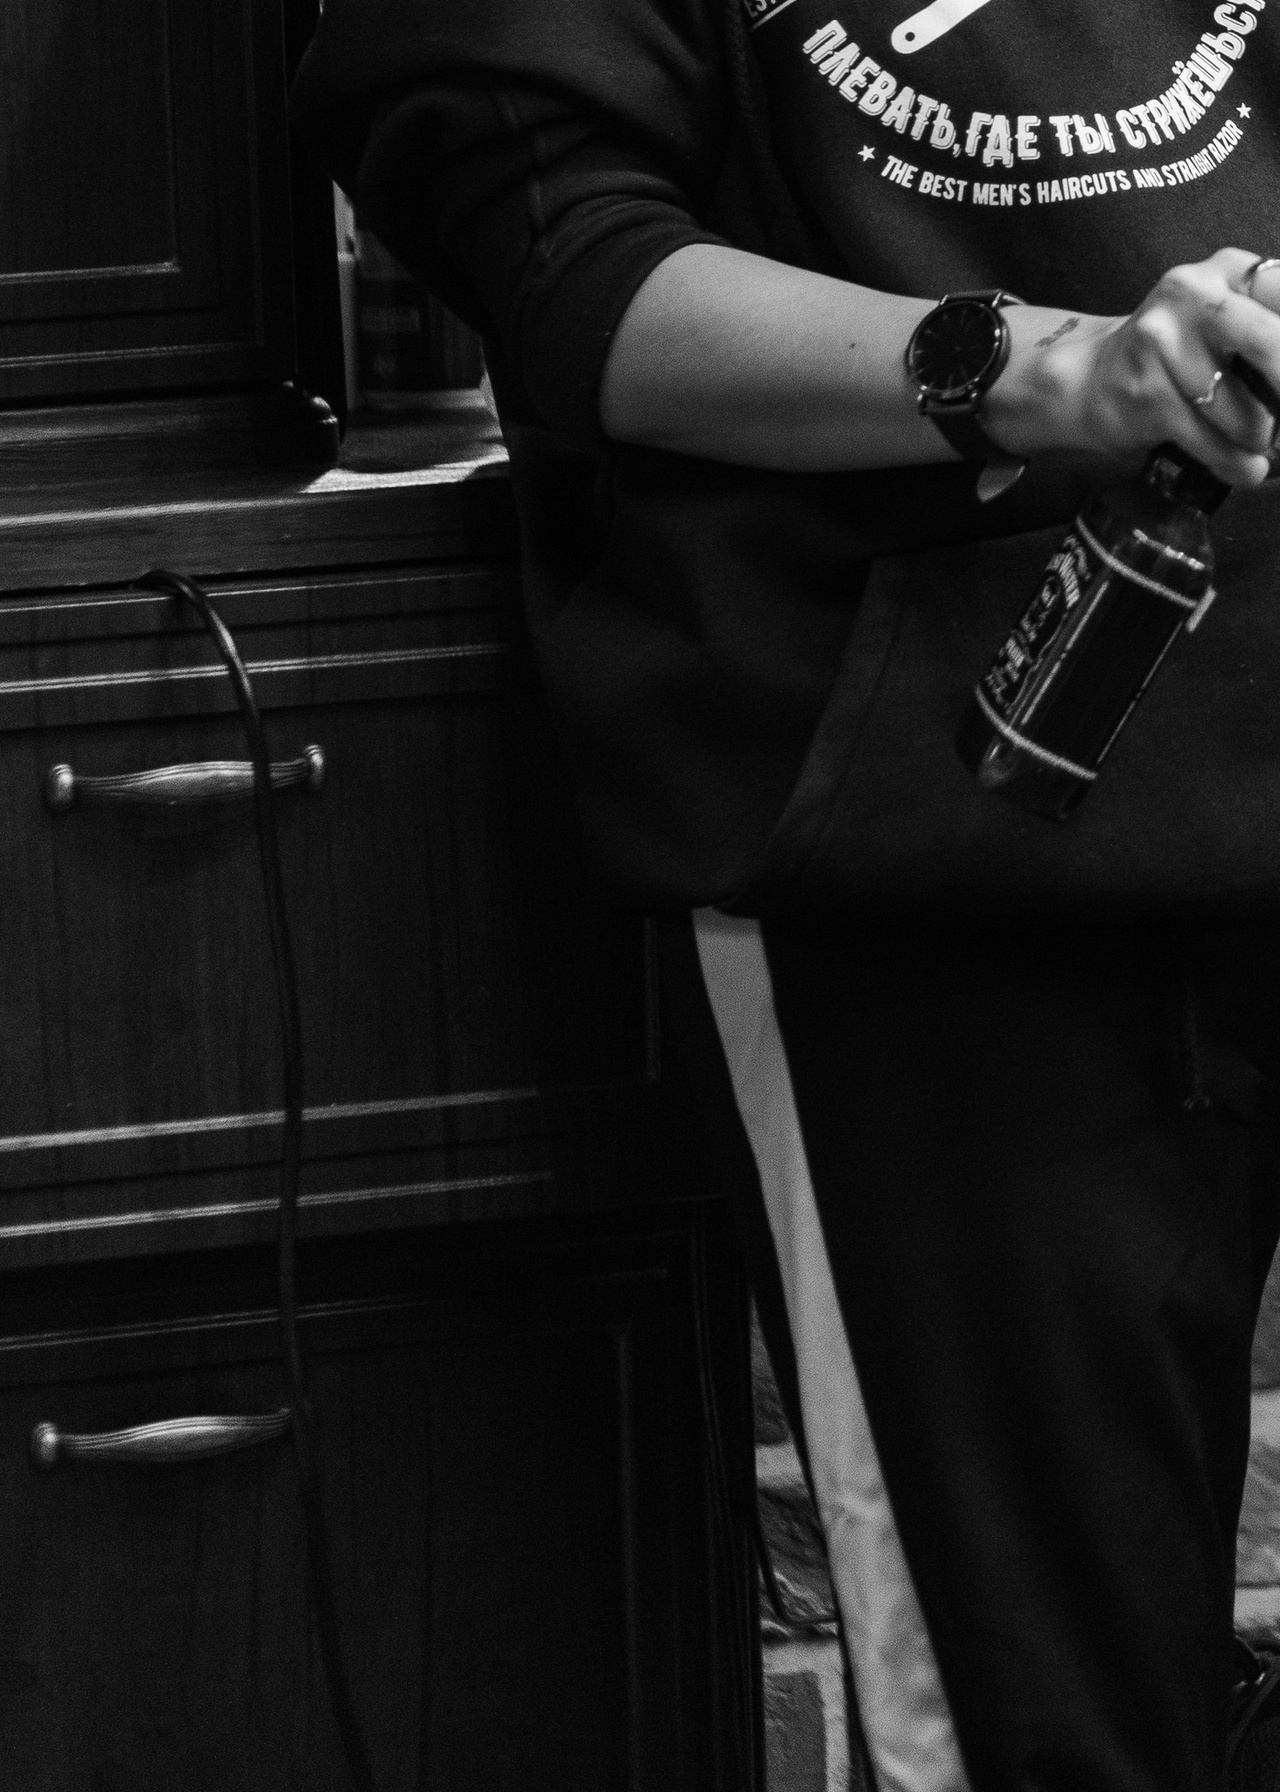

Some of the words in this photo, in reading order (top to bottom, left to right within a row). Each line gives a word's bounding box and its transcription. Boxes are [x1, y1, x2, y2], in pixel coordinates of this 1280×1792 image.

[881, 155, 918, 188] THE
[919, 171, 967, 201] BEST
[973, 182, 1031, 206] MEN'S
[1037, 170, 1131, 203] HAIRCUTS
[1132, 168, 1164, 188] AND
[1161, 148, 1217, 186] STRAIGHT
[1207, 119, 1244, 164] RAZOR
[1049, 113, 1116, 156] ТЫ
